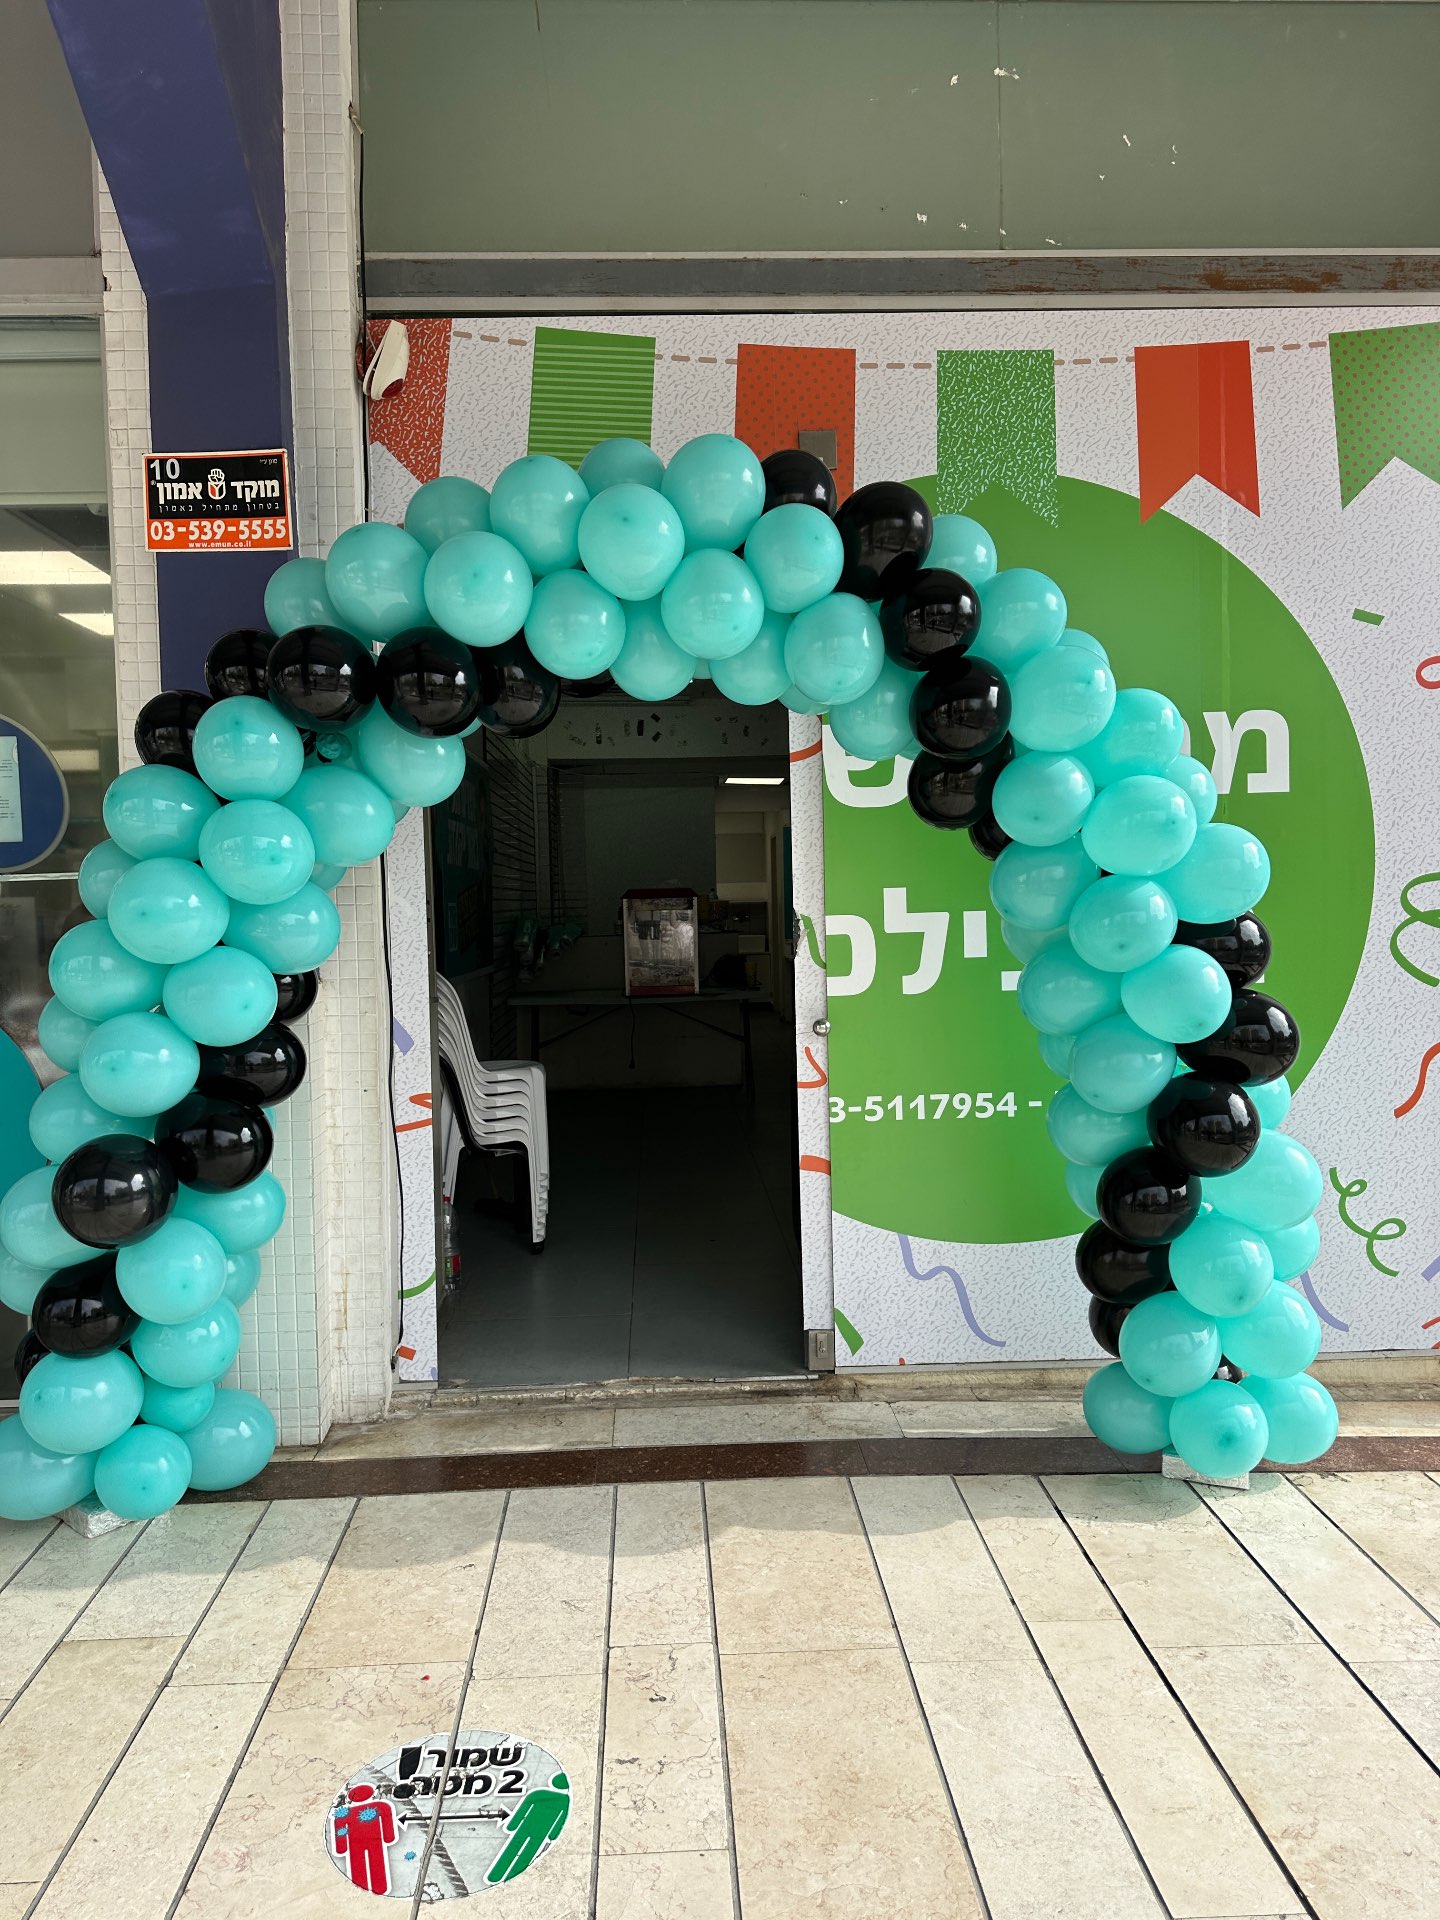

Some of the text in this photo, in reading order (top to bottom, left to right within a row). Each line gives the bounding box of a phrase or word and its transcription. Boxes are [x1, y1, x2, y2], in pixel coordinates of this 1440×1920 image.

[150, 458, 181, 480] 10
[230, 479, 280, 502] מוקד
[158, 502, 280, 514] בטחון מתחיל באמון
[150, 519, 287, 541] 03-539-5555
[497, 1769, 525, 1794] 2
